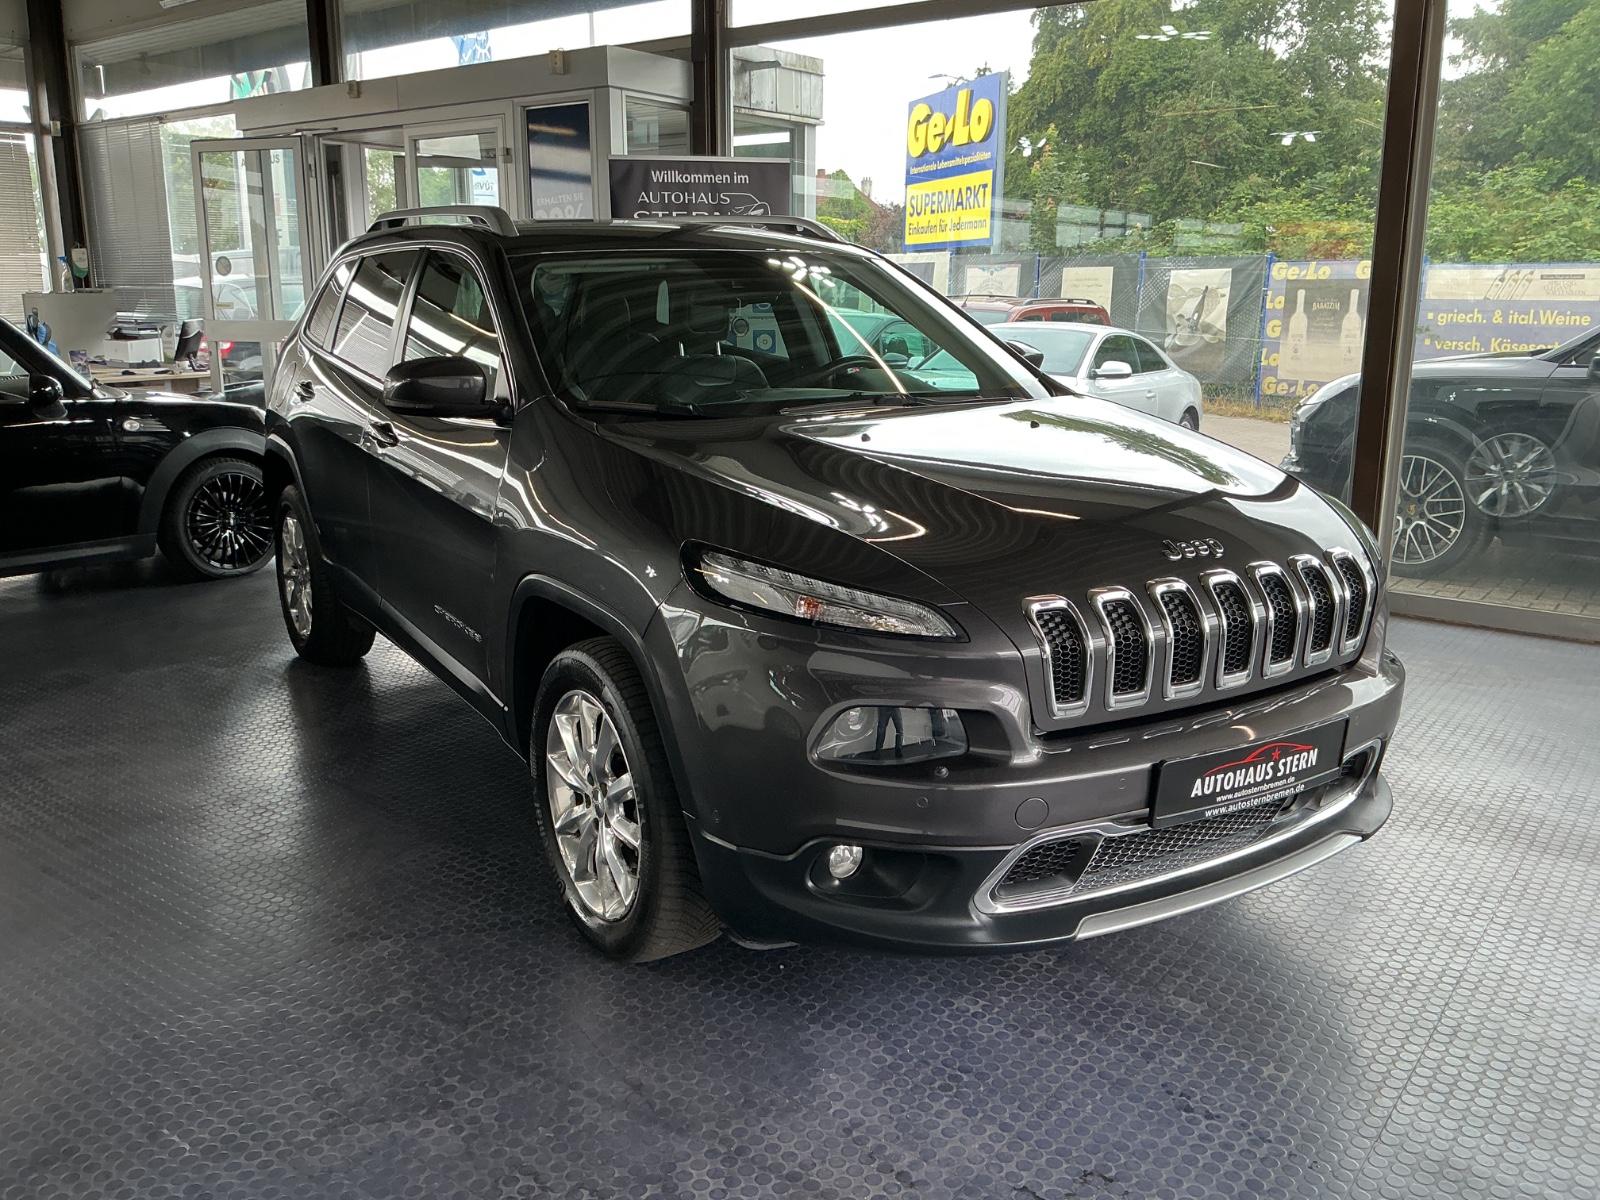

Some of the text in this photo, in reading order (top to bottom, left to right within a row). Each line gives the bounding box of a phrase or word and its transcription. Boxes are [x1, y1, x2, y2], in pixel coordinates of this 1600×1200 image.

[651, 170, 749, 184] Willkommen im
[637, 191, 731, 204] AUTOHAUS
[909, 183, 988, 217] SUPERMARKT
[908, 217, 987, 235] Einkaufen für Jedermann
[1437, 309, 1487, 325] griech.
[1492, 310, 1503, 324] &
[1435, 336, 1485, 351] versch.
[1161, 537, 1224, 561] Jeep
[1190, 748, 1318, 798] AUTOHAUS STERN
[1216, 775, 1295, 802] www.autosternbremen.de
[1205, 783, 1305, 817] www.autosternbremen.de
